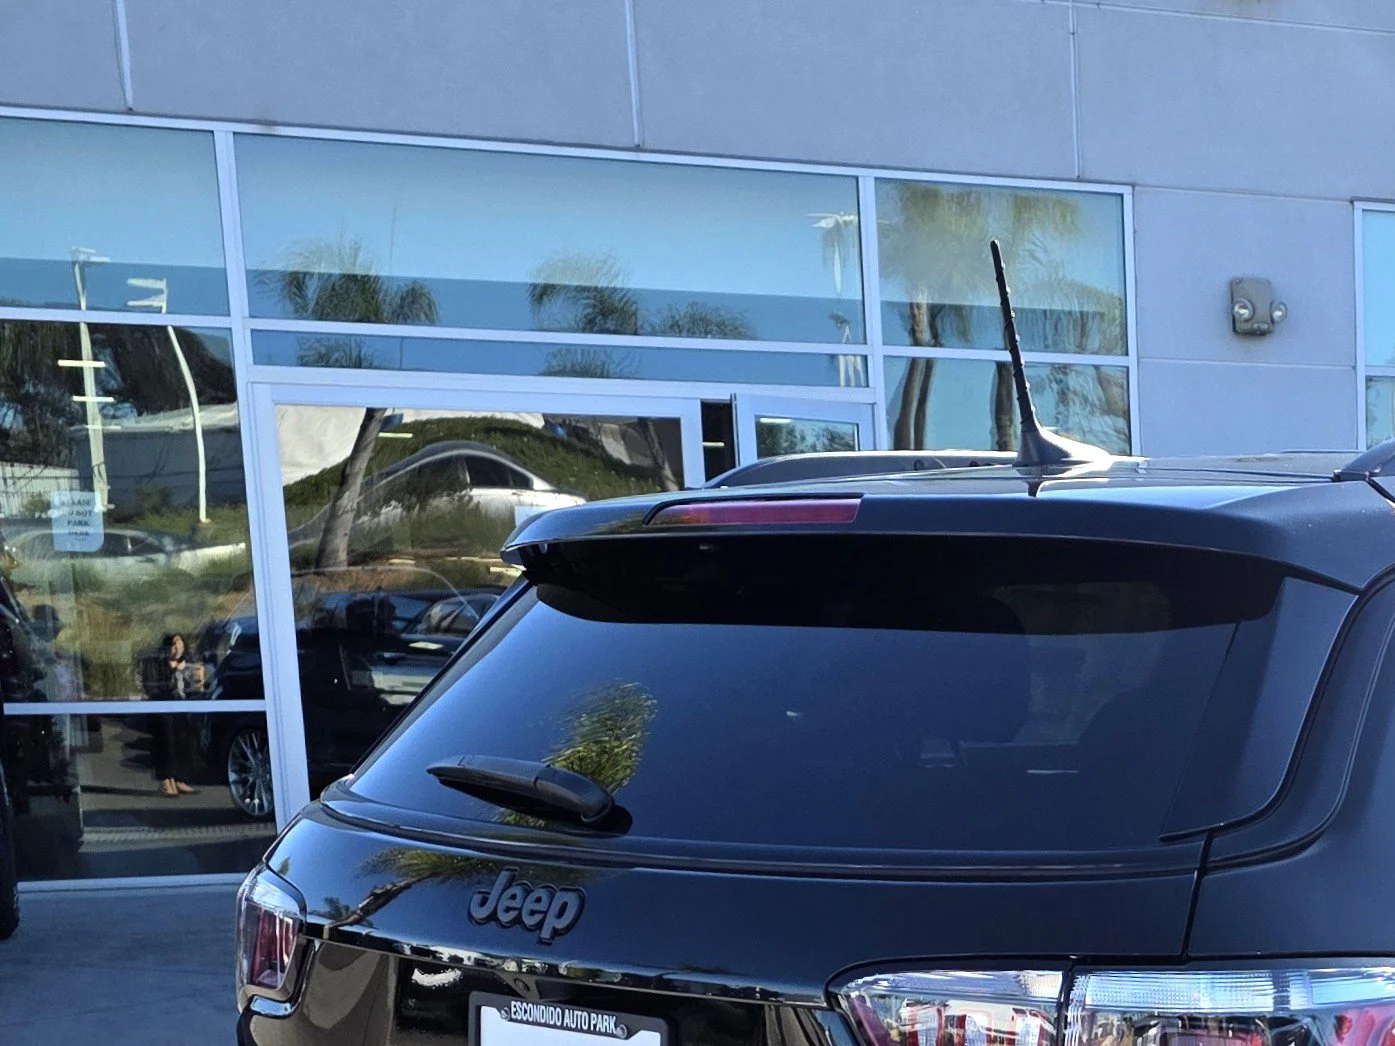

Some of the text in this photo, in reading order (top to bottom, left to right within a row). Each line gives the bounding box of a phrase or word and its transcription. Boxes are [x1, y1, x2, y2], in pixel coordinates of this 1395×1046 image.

[467, 866, 587, 946] Jeep
[510, 1000, 617, 1035] ESCONDIDO AUTO PARK
